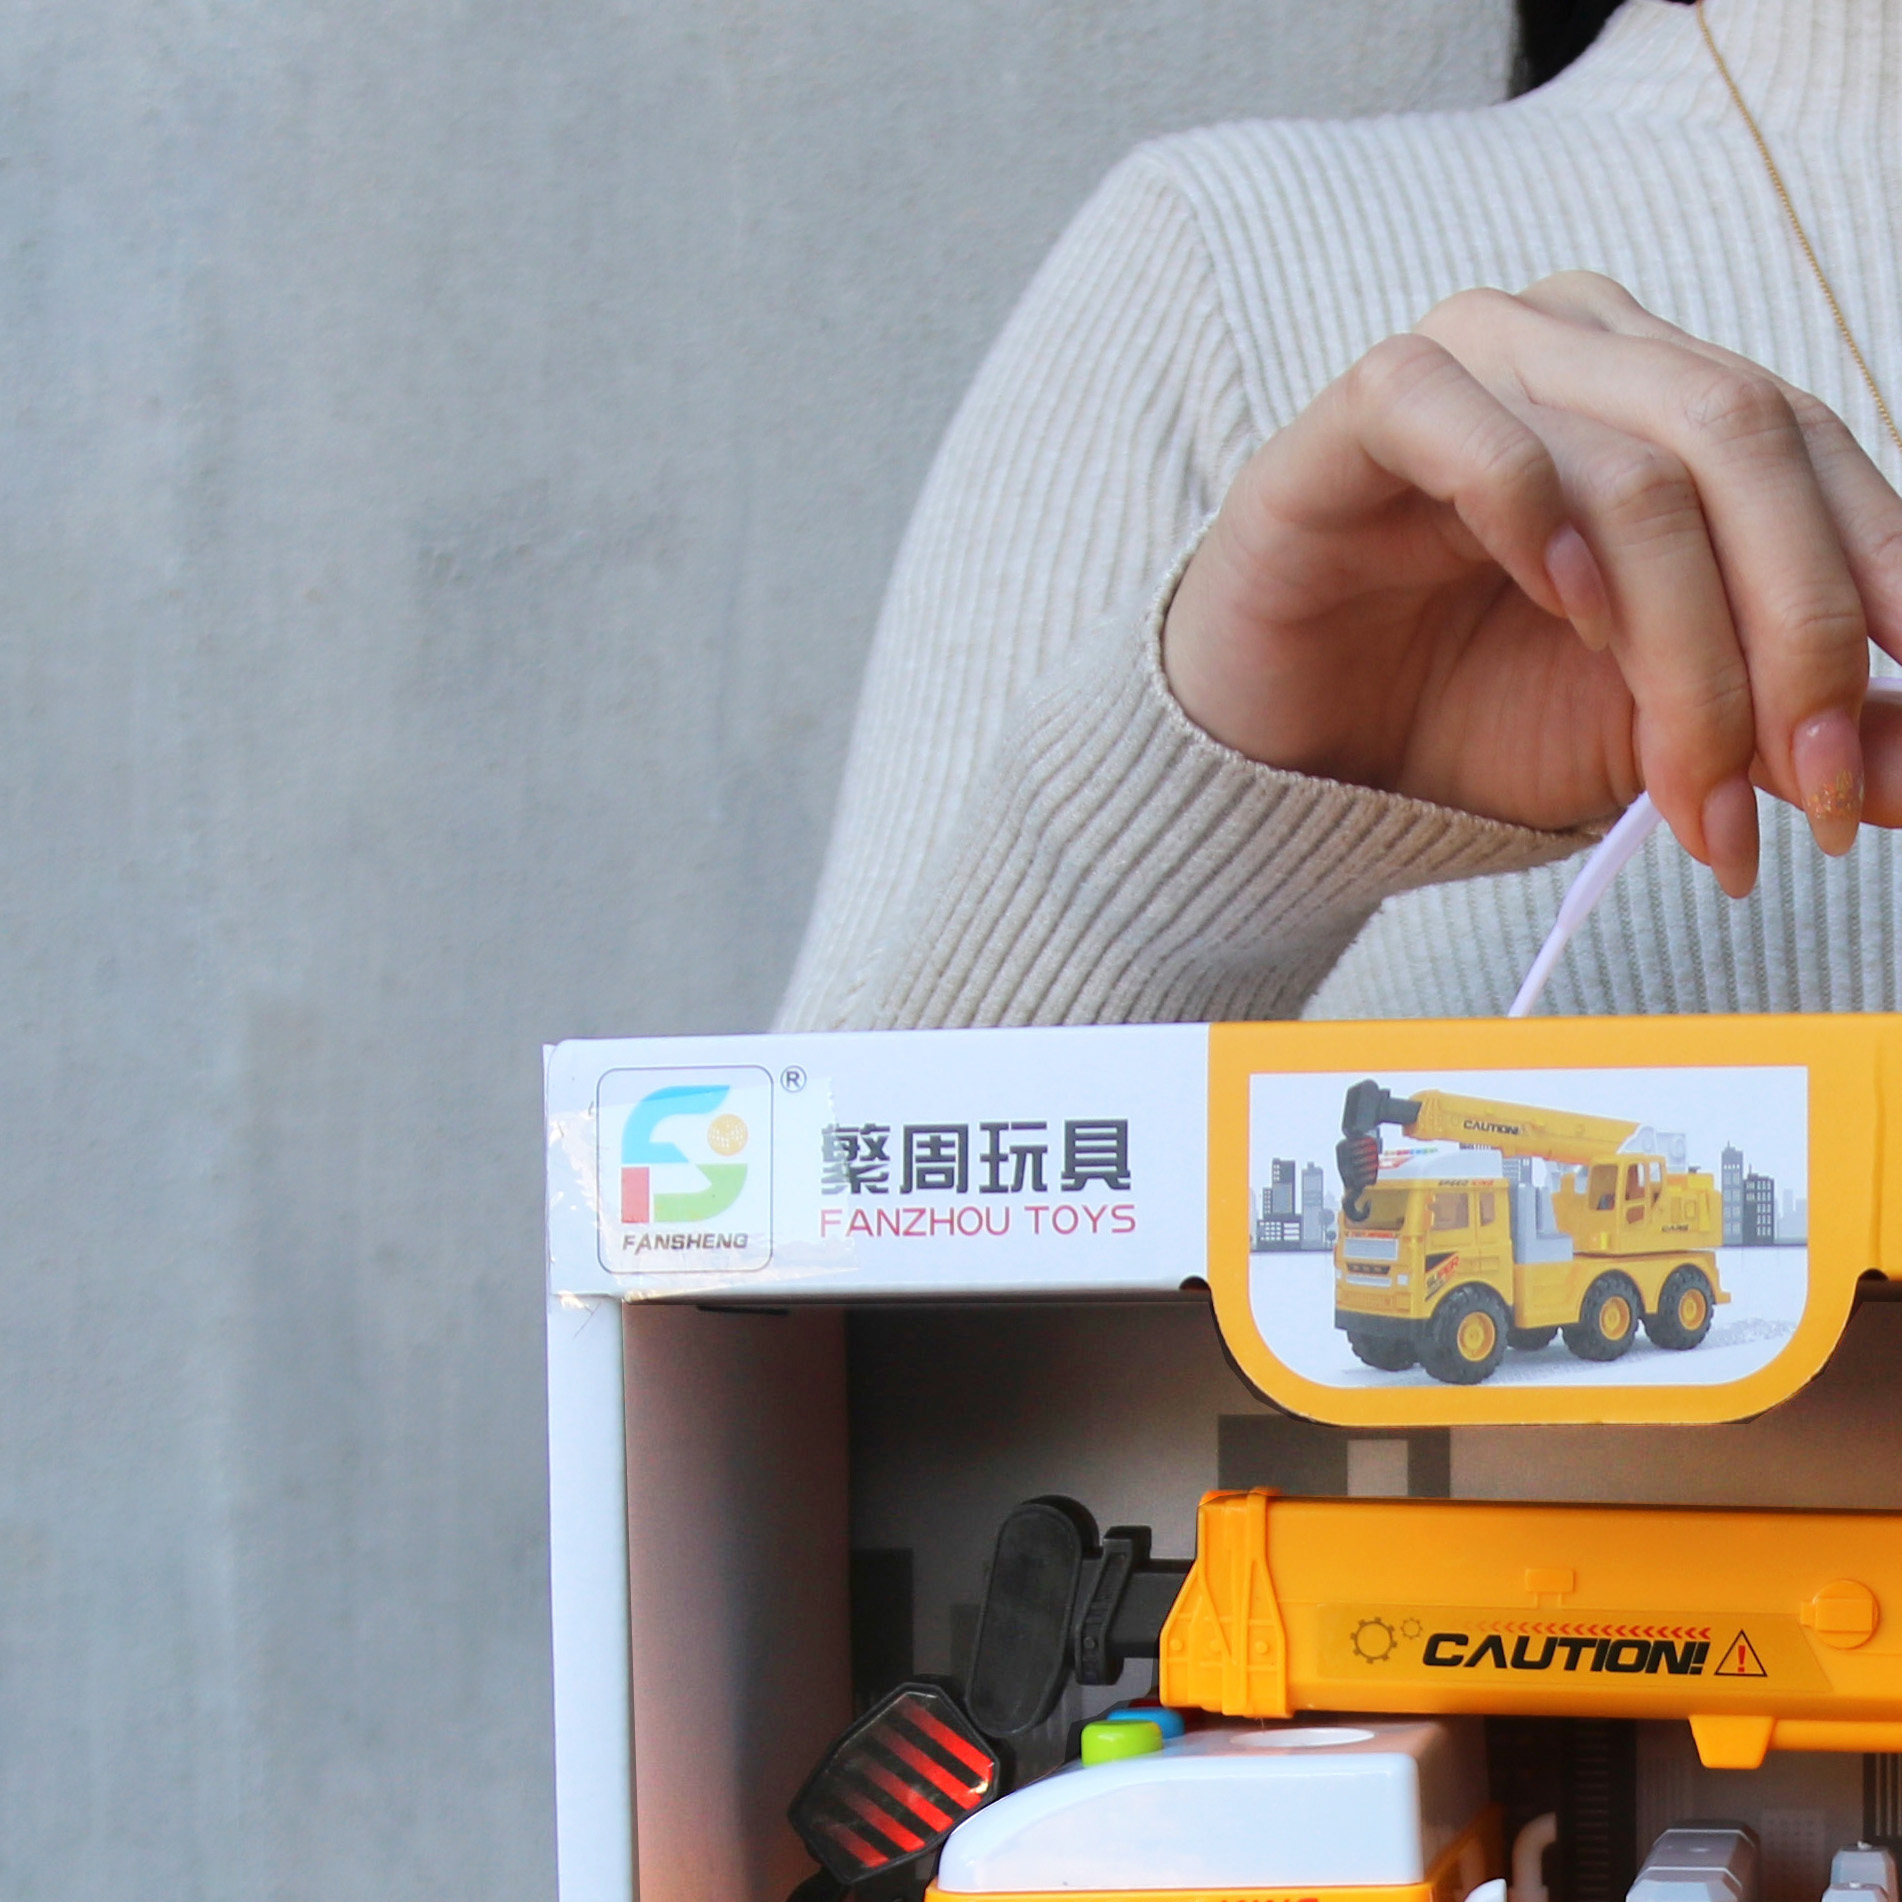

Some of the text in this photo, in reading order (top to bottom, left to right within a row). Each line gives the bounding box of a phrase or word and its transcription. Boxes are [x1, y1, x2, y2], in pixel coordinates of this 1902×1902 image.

[820, 1119, 1132, 1195] 繁周玩具
[820, 1204, 1136, 1238] FANZHOU TOYS
[622, 1232, 749, 1255] FANSHENG
[1422, 1632, 1711, 1676] CAUTION!
